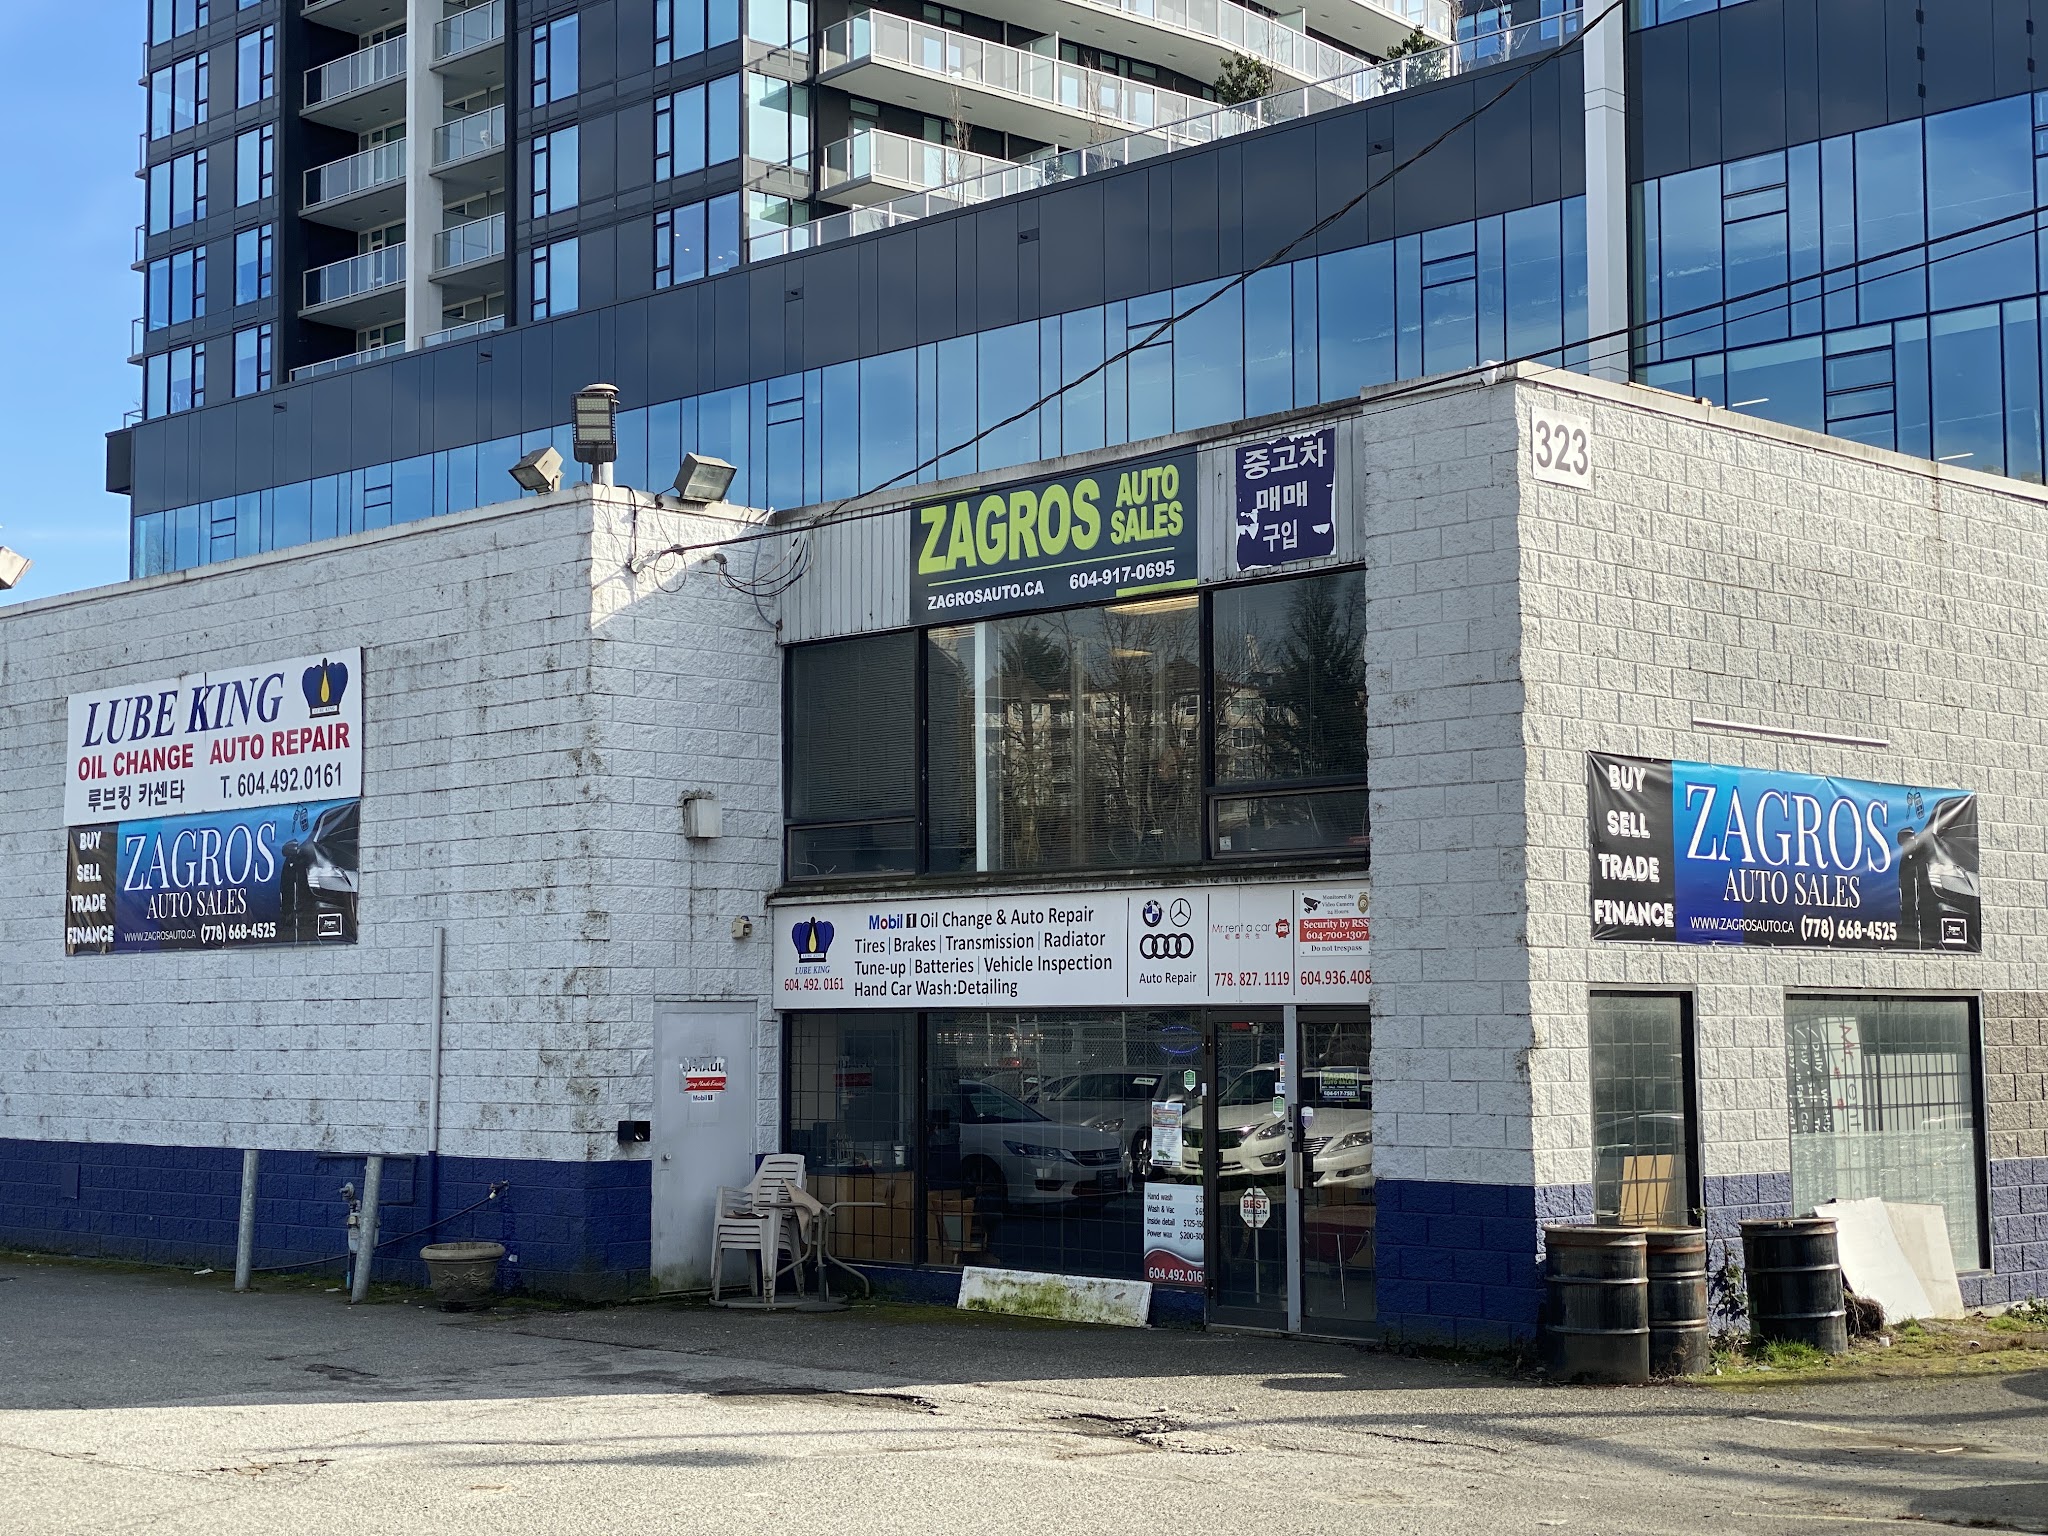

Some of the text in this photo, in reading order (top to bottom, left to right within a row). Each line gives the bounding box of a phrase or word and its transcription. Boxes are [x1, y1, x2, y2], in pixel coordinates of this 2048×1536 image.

[1243, 437, 1327, 480] 중고차
[1536, 420, 1588, 476] 323
[1115, 464, 1179, 508] AUTO
[1256, 480, 1308, 511] 매매
[918, 478, 1101, 575] ZAGROS
[1110, 500, 1183, 545] SALES
[1263, 519, 1298, 552] 구입
[1069, 559, 1175, 590] 604-917-0695
[927, 580, 1045, 610] ZAGROSAUTO.CA
[82, 672, 284, 747] LUBE KING
[209, 722, 350, 765] AUTO REPAIR
[78, 743, 194, 781] OIL CHANGE
[220, 761, 342, 799] T. 604.492.0161
[1608, 765, 1647, 793] BUY
[88, 779, 185, 813] 루브킹 카센타
[1607, 810, 1650, 839] SELL
[1685, 781, 1892, 873] ZAGROS
[79, 830, 102, 851] BUY
[123, 820, 277, 892] ZAGROS
[1598, 853, 1660, 883] TRADE
[76, 863, 102, 883] SELL
[71, 893, 107, 913] TRADE
[146, 887, 247, 919] AUTO SALES
[1723, 869, 1861, 909] AUTO SALES
[869, 906, 1094, 930] Mobil 1 Oil Change & Auto Repair
[1246, 924, 1252, 932] a
[1255, 923, 1271, 932] car
[1303, 918, 1369, 930] Security by RSS
[1594, 899, 1675, 928] FINANCE
[67, 925, 114, 945] FINANCE
[124, 922, 277, 944] WWW.ZAGROSAUTO.CA (778) 668-4525
[854, 931, 1105, 953] Tires Brakes Transmission Radiator
[1306, 930, 1367, 941] 604-700-1307
[1690, 914, 1897, 942] WWW.ZAGROSAUTO.CA (778) 668-4525
[795, 965, 830, 975] LUBE KING
[854, 954, 1112, 977] Tune-up Batteries Vehicle Inspection
[1139, 971, 1197, 985] Auto Repair
[1300, 970, 1372, 985] 604.936.408
[854, 981, 887, 996] Hand
[891, 981, 912, 996] Car
[1812, 1041, 1823, 1072] Daily
[1796, 1084, 1807, 1108] Fast
[1147, 1204, 1160, 1213] Wash
[1161, 1205, 1165, 1213] &
[1166, 1206, 1175, 1214] Vac
[1243, 1200, 1267, 1209] BEST
[1147, 1217, 1160, 1225] Inside
[1162, 1218, 1175, 1226] detail
[1147, 1229, 1161, 1238] Power
[1148, 1267, 1204, 1283] 604.492.016
